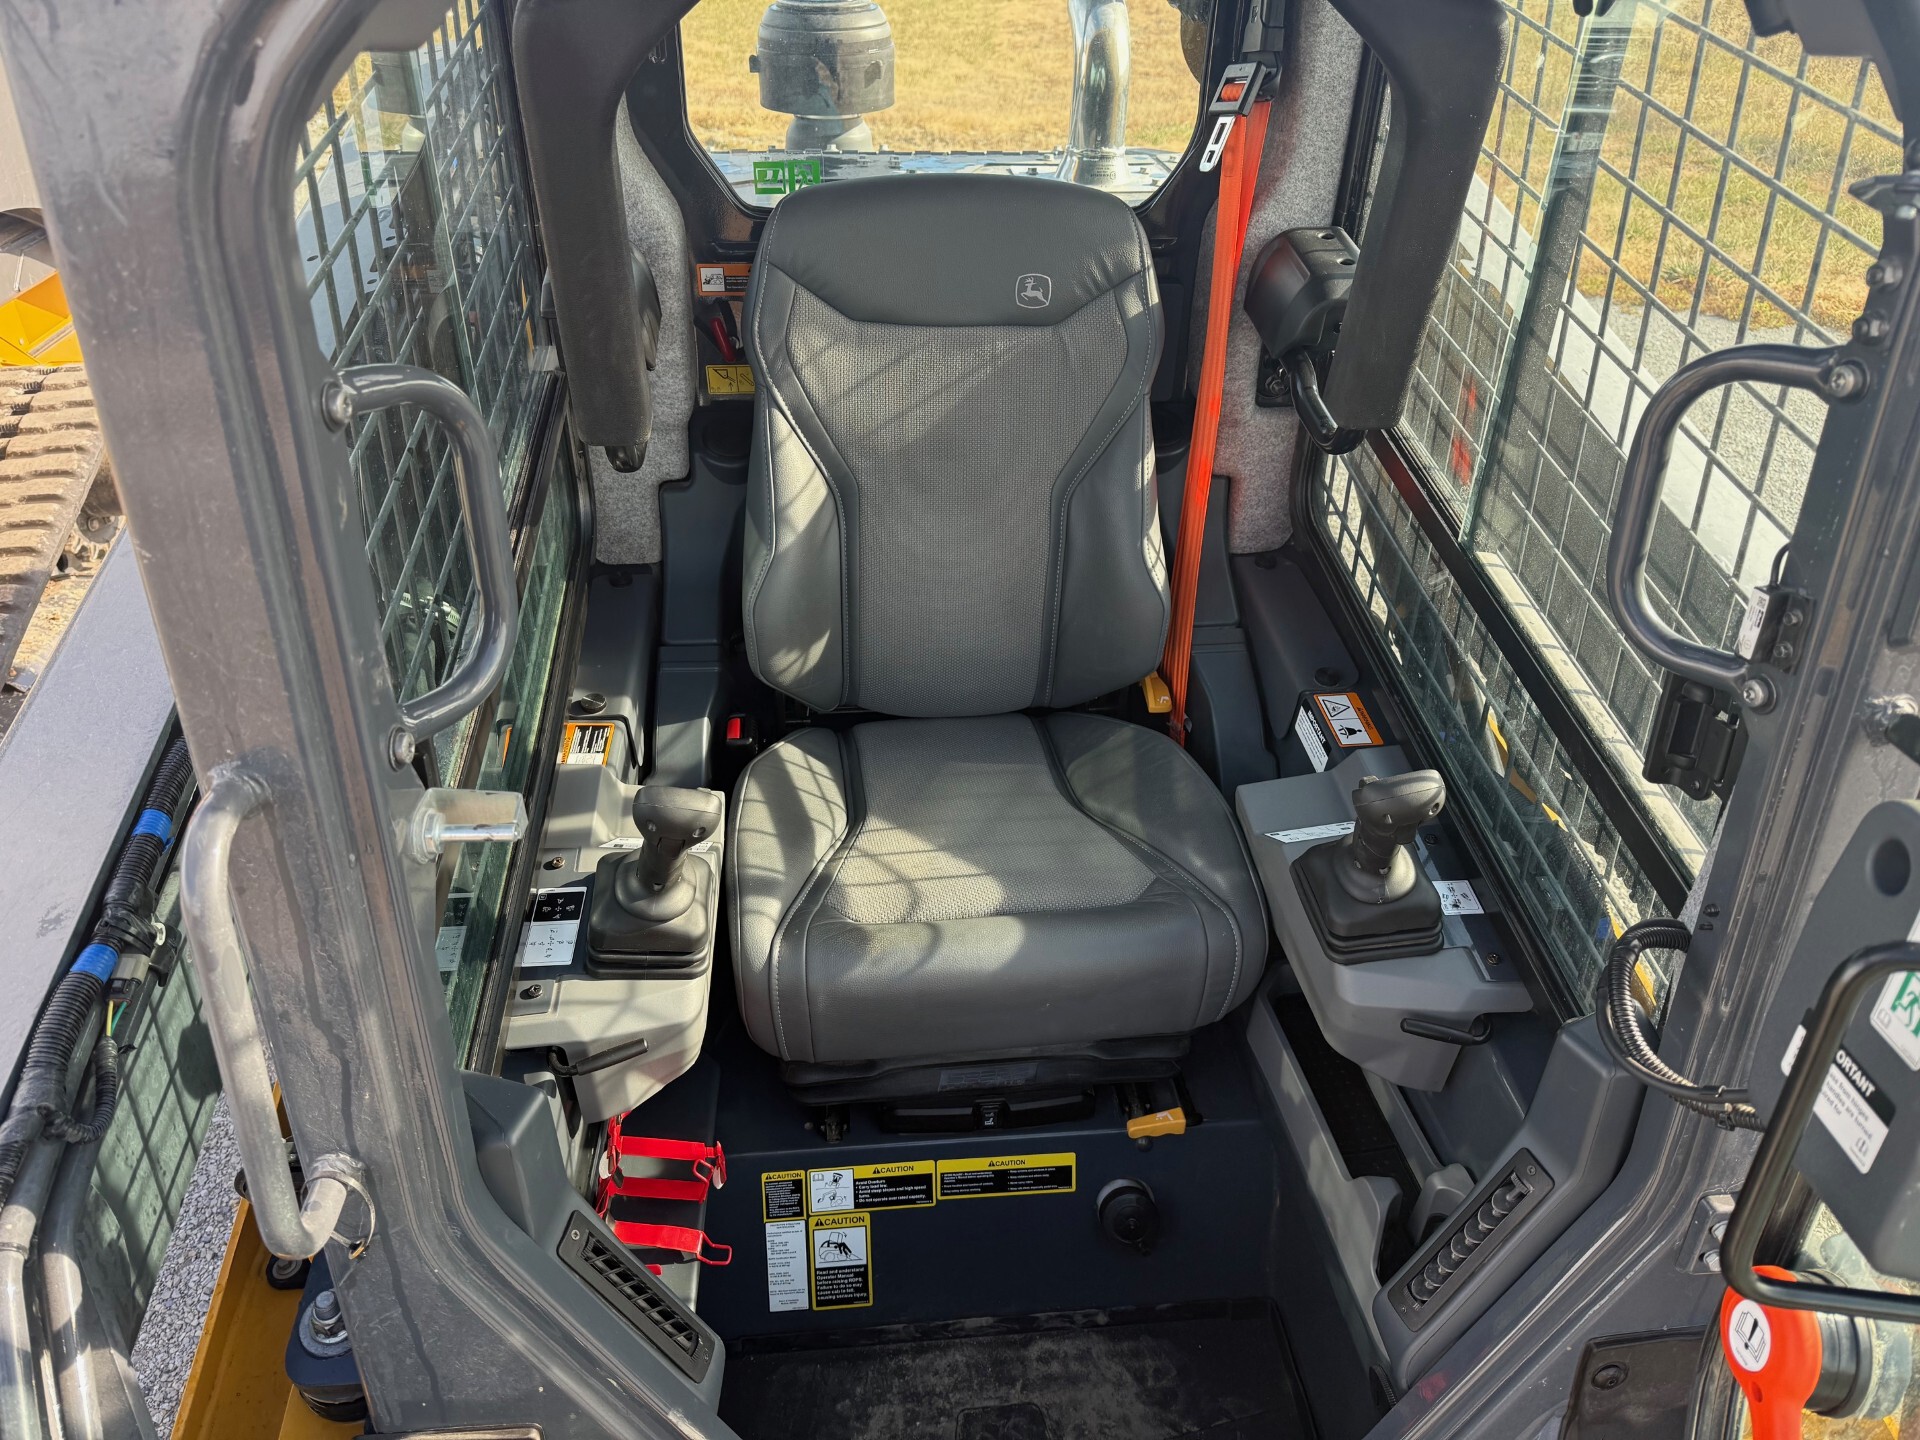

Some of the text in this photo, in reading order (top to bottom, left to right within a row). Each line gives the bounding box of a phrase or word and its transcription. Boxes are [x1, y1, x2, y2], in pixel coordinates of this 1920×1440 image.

[1307, 710, 1327, 744] IMPORTANT
[1835, 1049, 1876, 1097] ORTANT
[995, 1159, 1026, 1168] CAUTION
[880, 1165, 914, 1175] CAUTION
[772, 1172, 802, 1181] CAUTION
[824, 1215, 865, 1227] CAUTION
